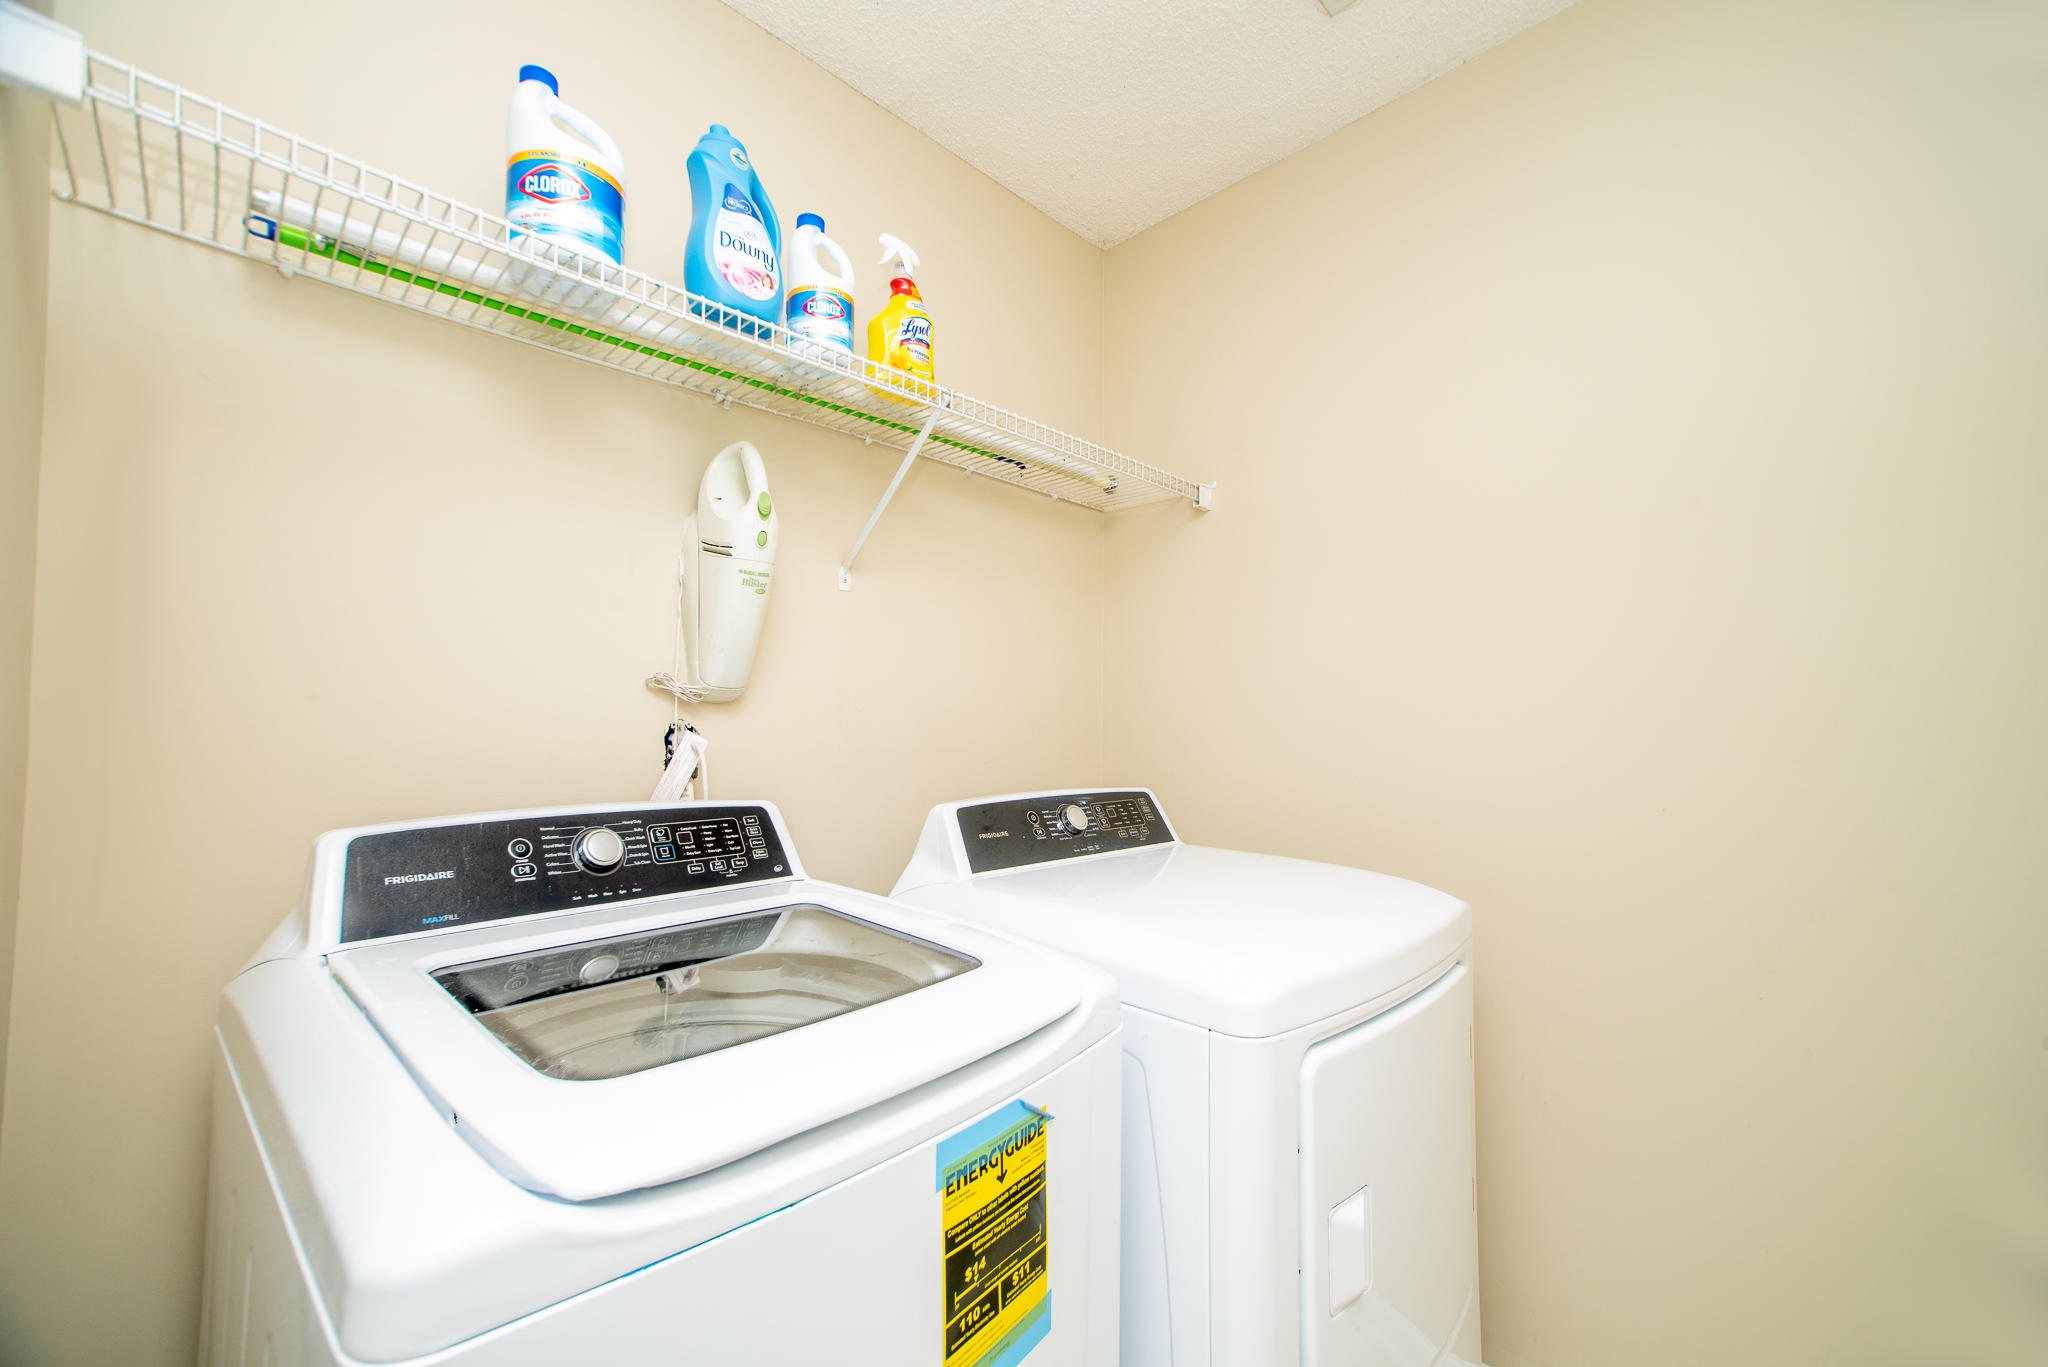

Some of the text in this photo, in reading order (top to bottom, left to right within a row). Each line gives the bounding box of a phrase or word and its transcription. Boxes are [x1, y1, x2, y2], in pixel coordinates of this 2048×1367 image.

[525, 175, 581, 200] CLOROX
[720, 230, 774, 272] Downy
[807, 301, 841, 316] CLOROX
[901, 319, 931, 339] Lysol
[978, 830, 1009, 839] FRIGIDAIRE
[384, 870, 455, 886] FRIGIDAIRE
[422, 914, 460, 925] MAXFILL
[946, 1118, 1044, 1197] ENERGYGUIDE
[969, 1210, 981, 1226] ONLY
[965, 1256, 986, 1282] $14
[1012, 1261, 1030, 1286] $11
[960, 1306, 980, 1332] 110
